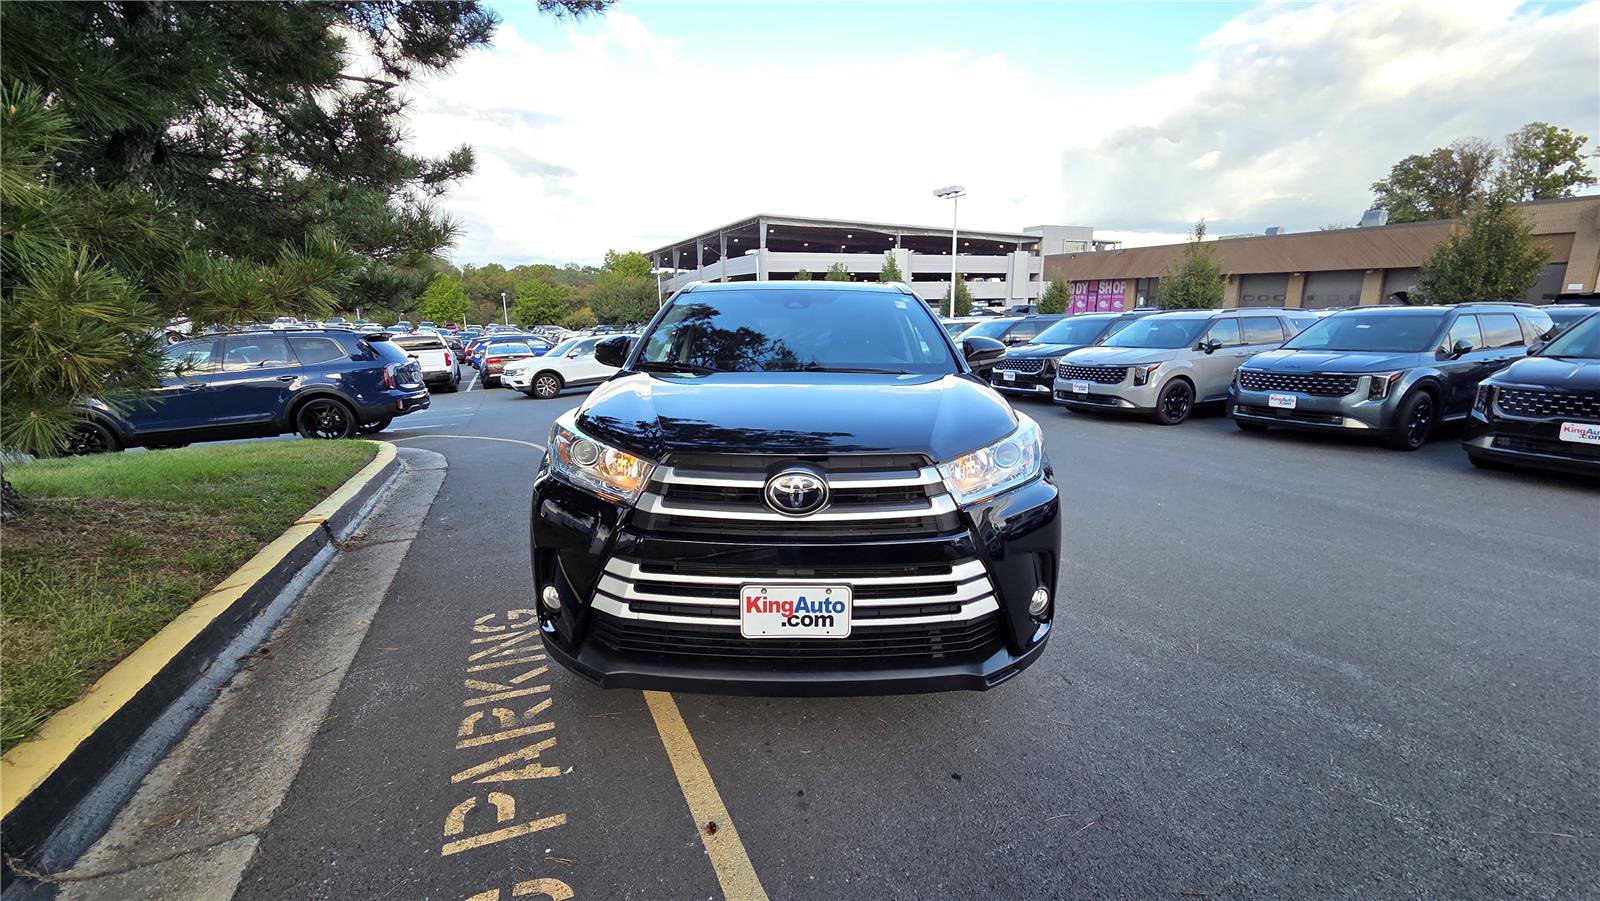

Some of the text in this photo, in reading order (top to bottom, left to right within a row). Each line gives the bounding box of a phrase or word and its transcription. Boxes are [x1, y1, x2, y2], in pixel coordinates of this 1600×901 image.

[1070, 281, 1127, 295] ODY SHOP
[1563, 426, 1600, 436] KingAu
[745, 596, 846, 618] KingAuto
[781, 614, 834, 627] .com
[440, 608, 568, 857] PARKING
